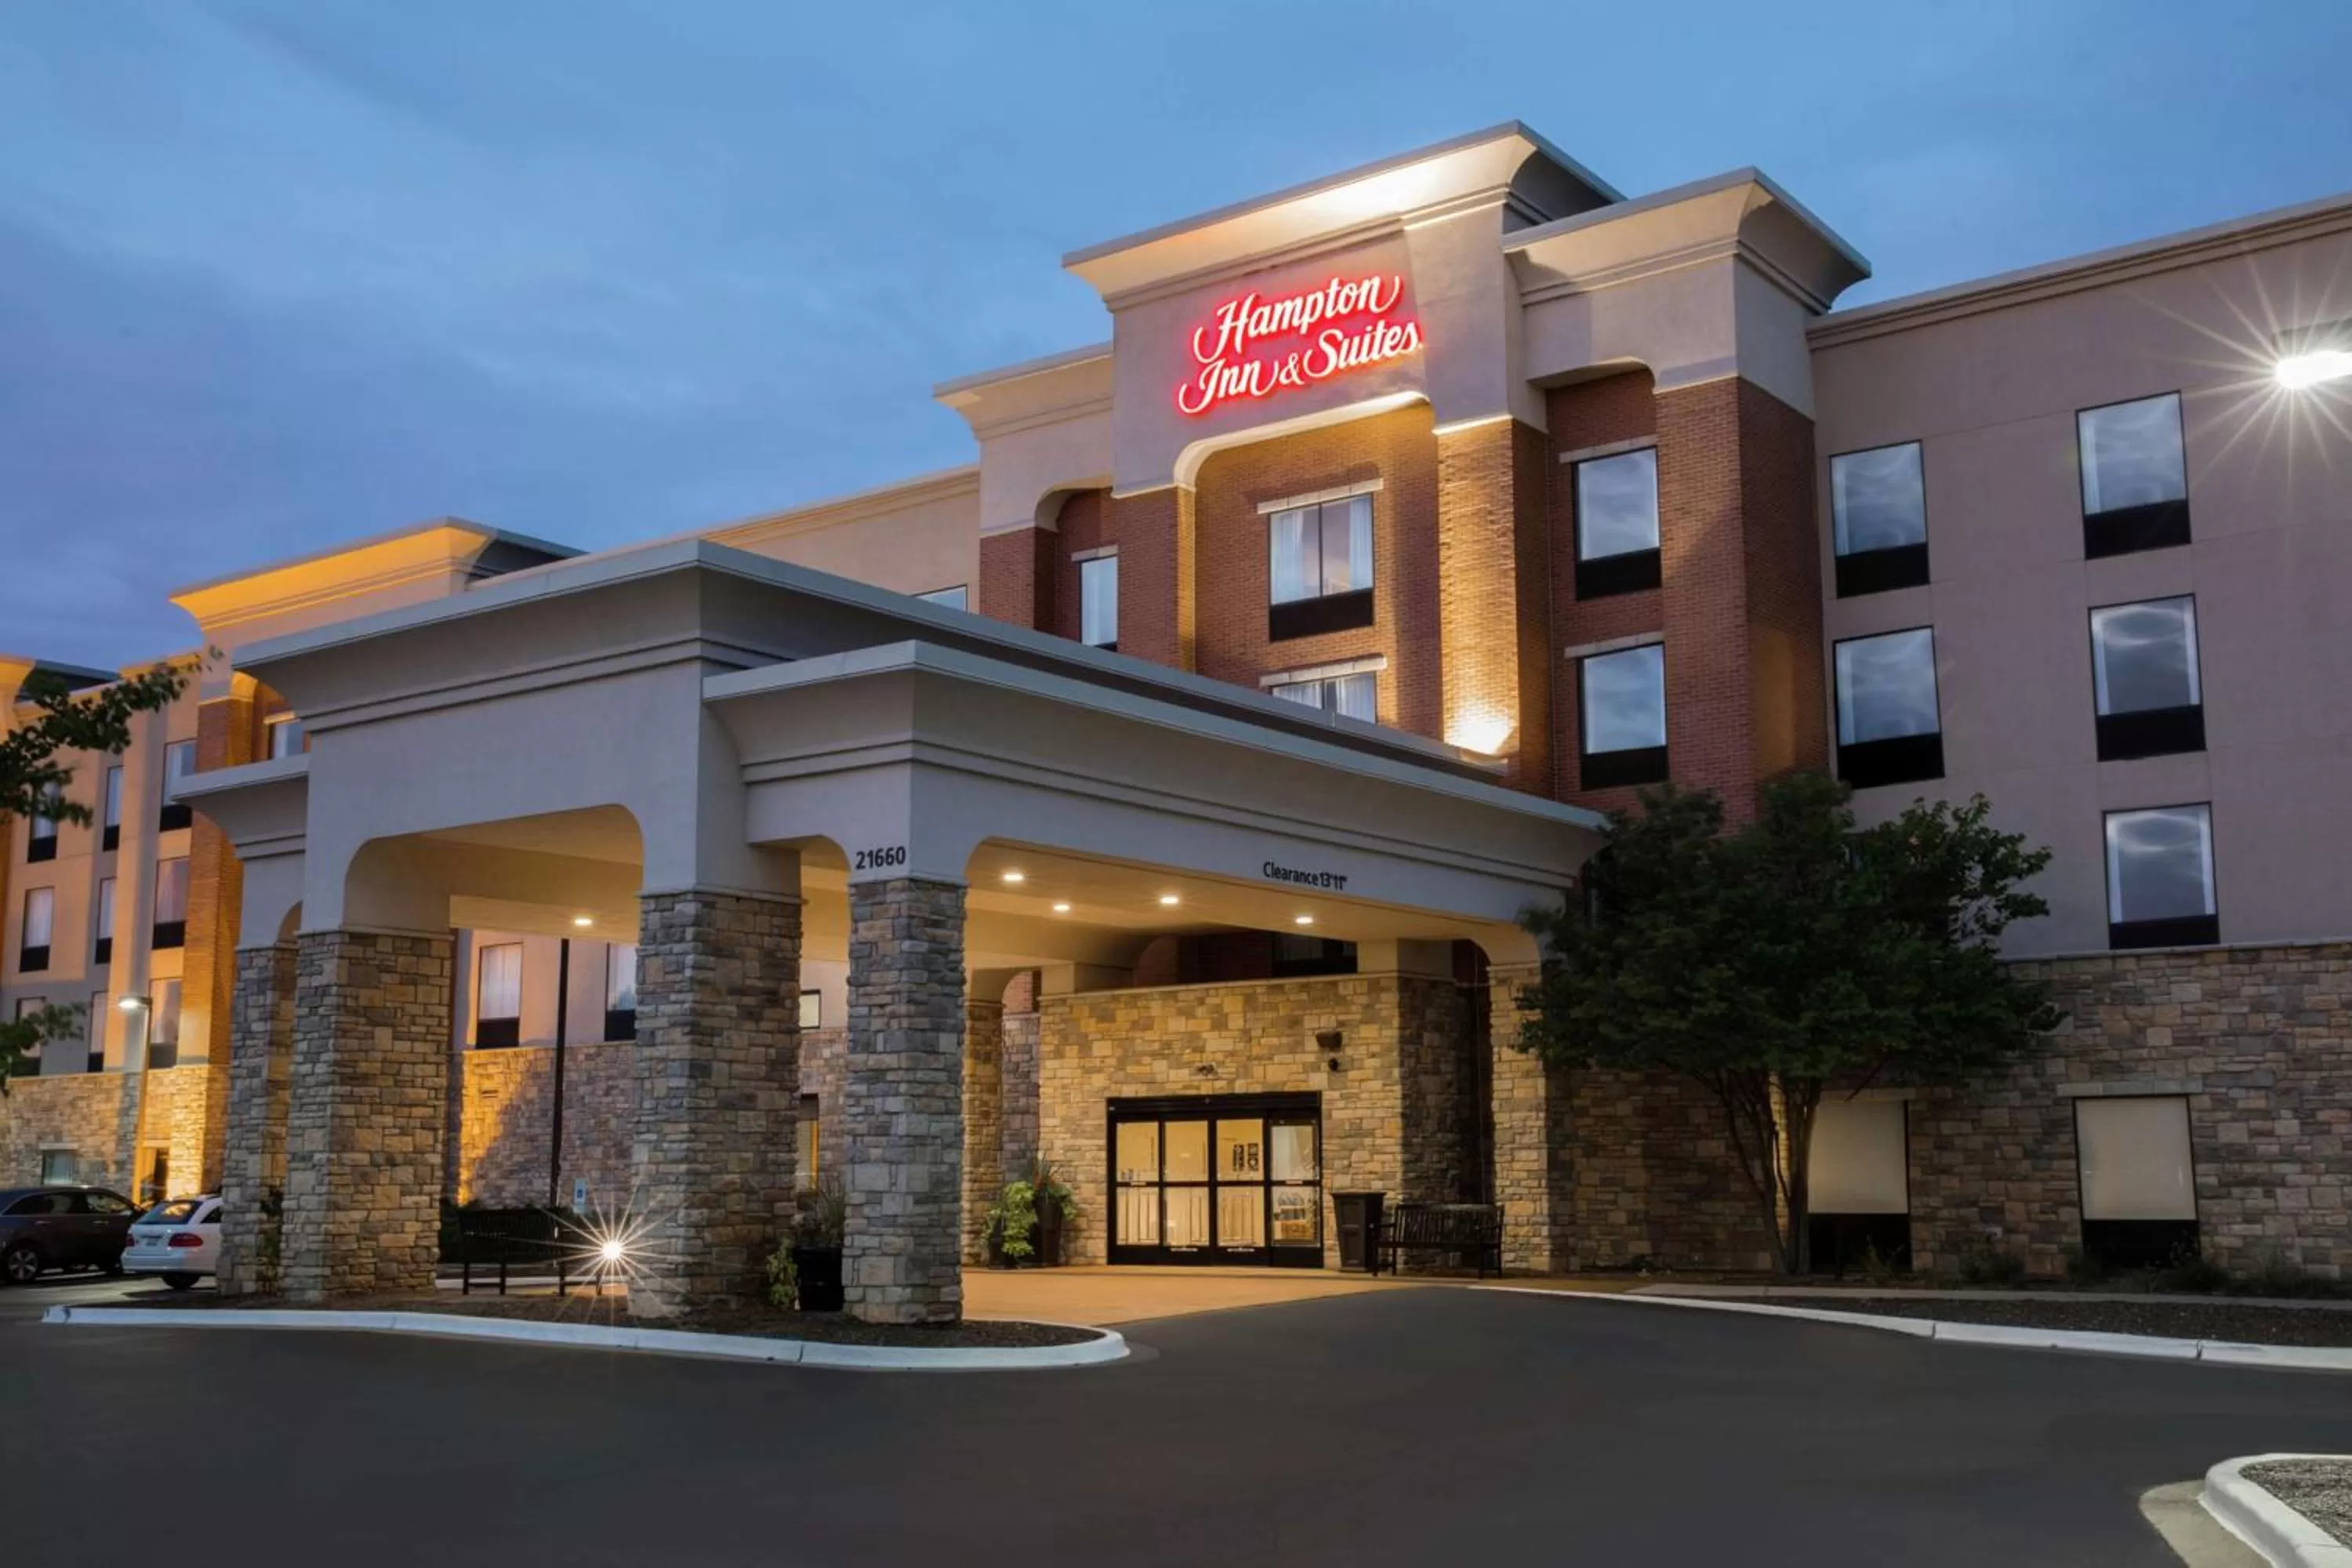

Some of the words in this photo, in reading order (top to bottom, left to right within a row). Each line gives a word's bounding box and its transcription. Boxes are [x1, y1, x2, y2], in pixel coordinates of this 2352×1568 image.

[1192, 275, 1401, 365] Hampton
[1178, 358, 1279, 414] Inn
[1279, 353, 1305, 386] &
[1303, 319, 1419, 378] Suites
[855, 846, 906, 870] 21660
[1263, 860, 1318, 887] Clearance
